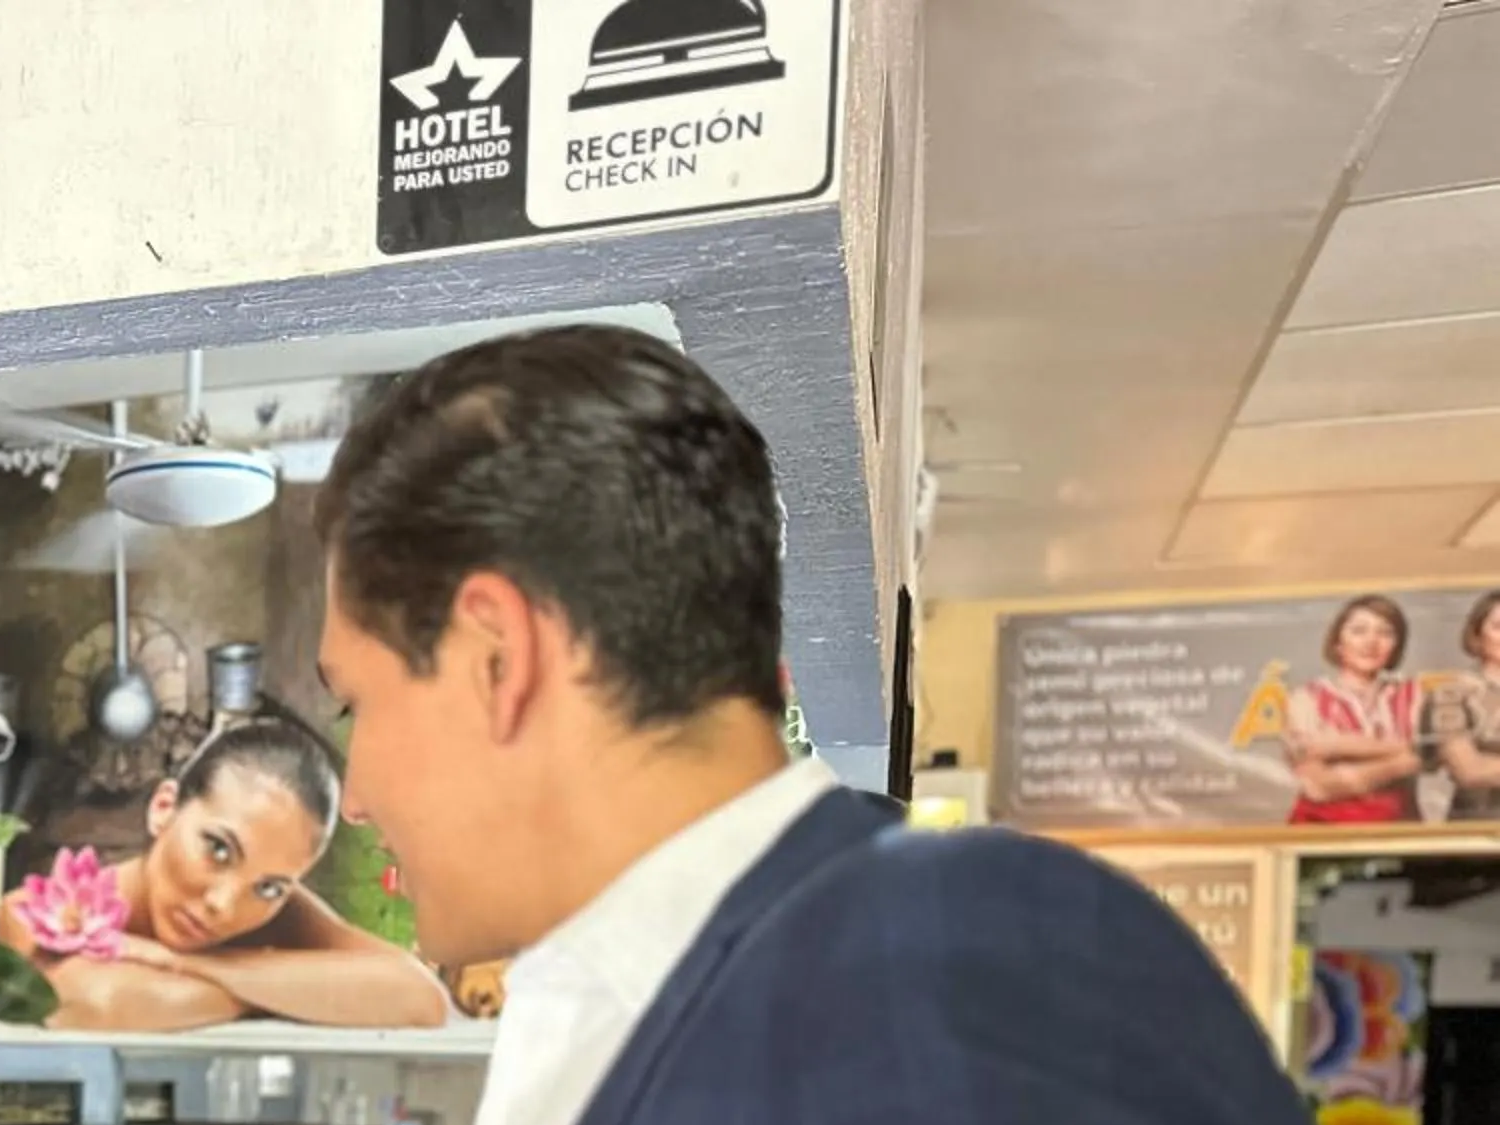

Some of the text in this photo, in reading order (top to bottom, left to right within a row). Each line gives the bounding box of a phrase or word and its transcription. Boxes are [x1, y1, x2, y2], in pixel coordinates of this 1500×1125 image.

[394, 105, 512, 150] HOTEL
[566, 108, 764, 165] RECEPCIÓN
[393, 141, 511, 171] MEJORANDO
[393, 160, 510, 192] PARA USTED
[565, 154, 697, 192] CHECK IN
[1209, 664, 1245, 685] de
[1021, 729, 1072, 748] que
[1197, 881, 1249, 907] un
